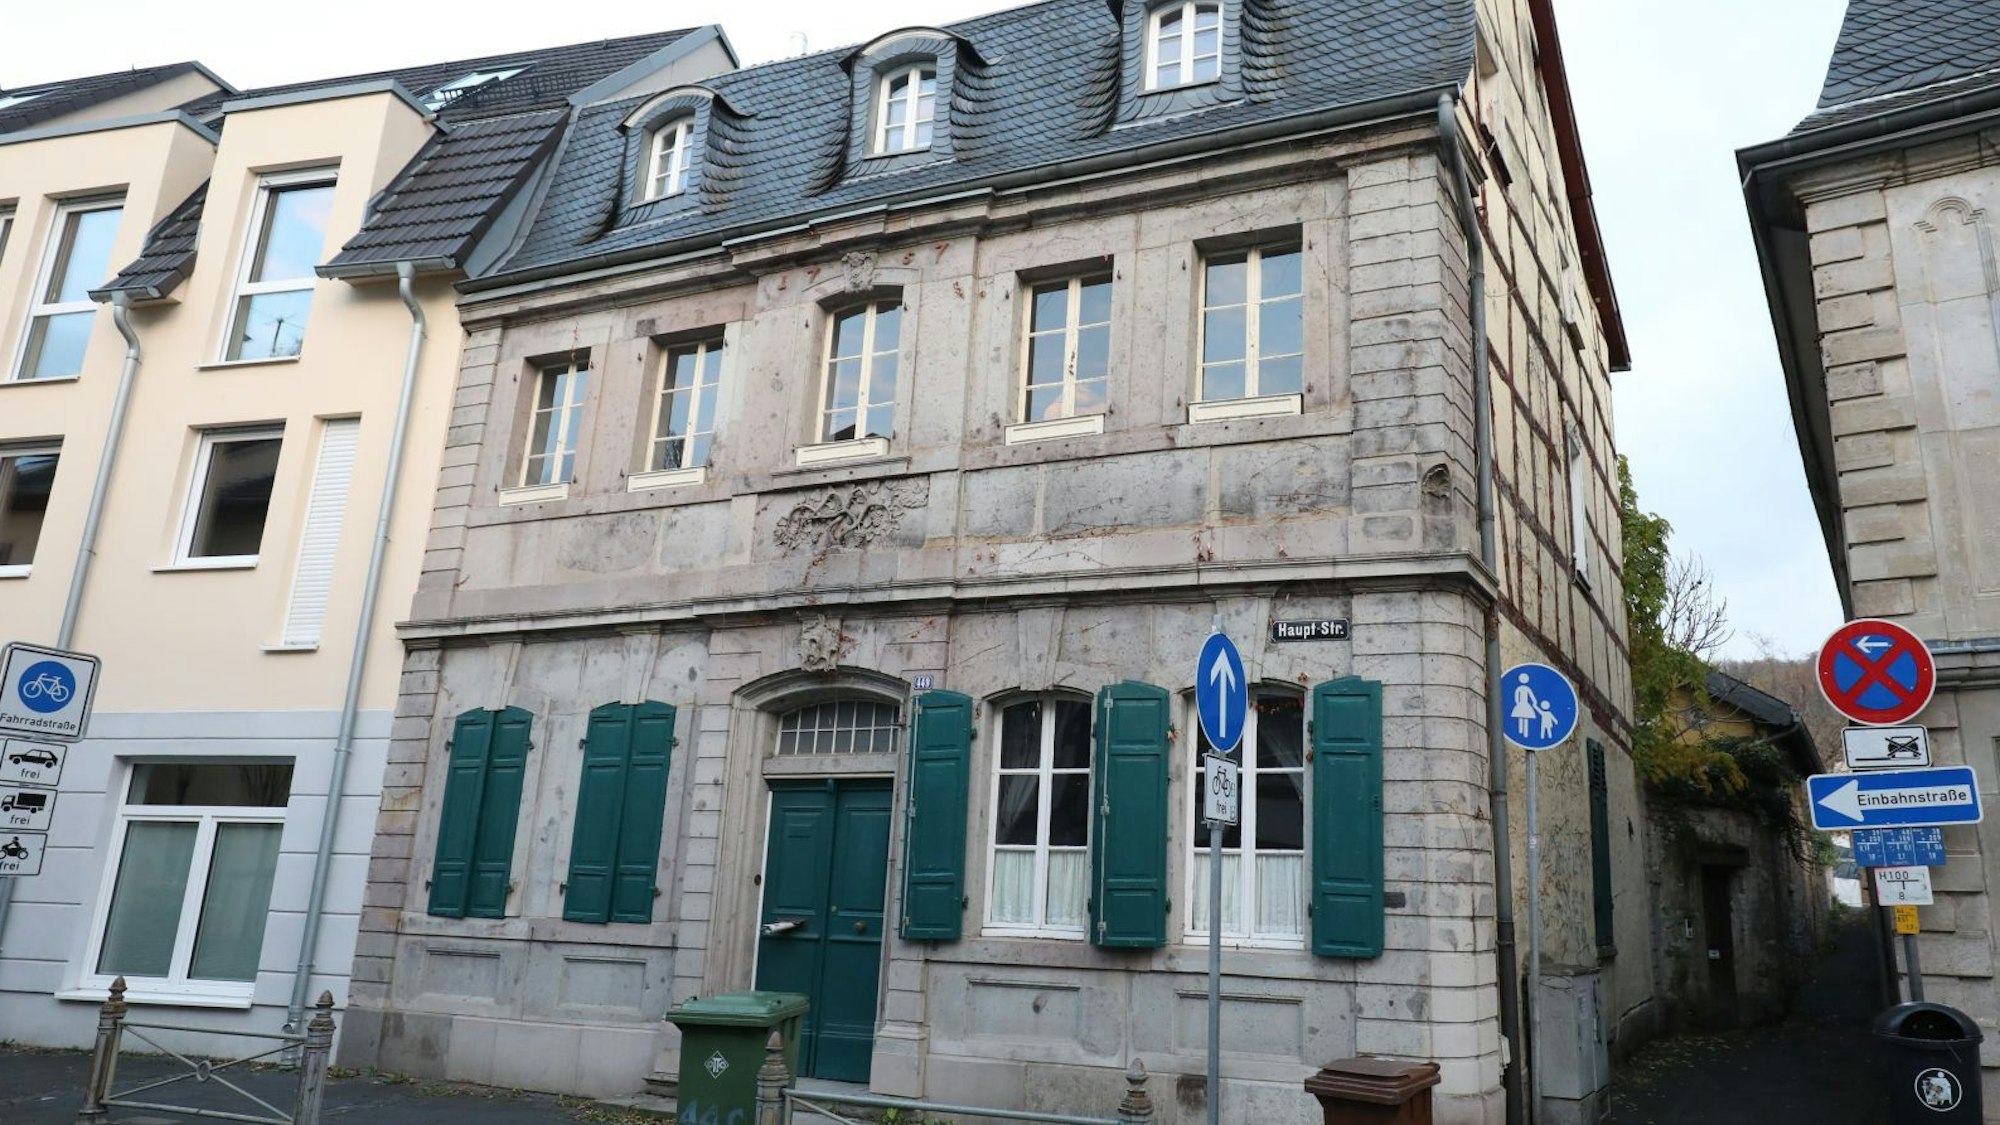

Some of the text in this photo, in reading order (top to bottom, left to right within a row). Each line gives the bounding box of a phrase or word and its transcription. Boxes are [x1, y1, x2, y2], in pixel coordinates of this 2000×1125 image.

[1278, 621, 1345, 639] Haupt-Str.
[0, 712, 77, 731] Fahrradstraße
[20, 768, 41, 780] frei
[1857, 789, 1967, 806] Einbahnstraße
[1216, 800, 1227, 814] frei
[10, 815, 31, 826] frei
[1879, 870, 1909, 881] H100
